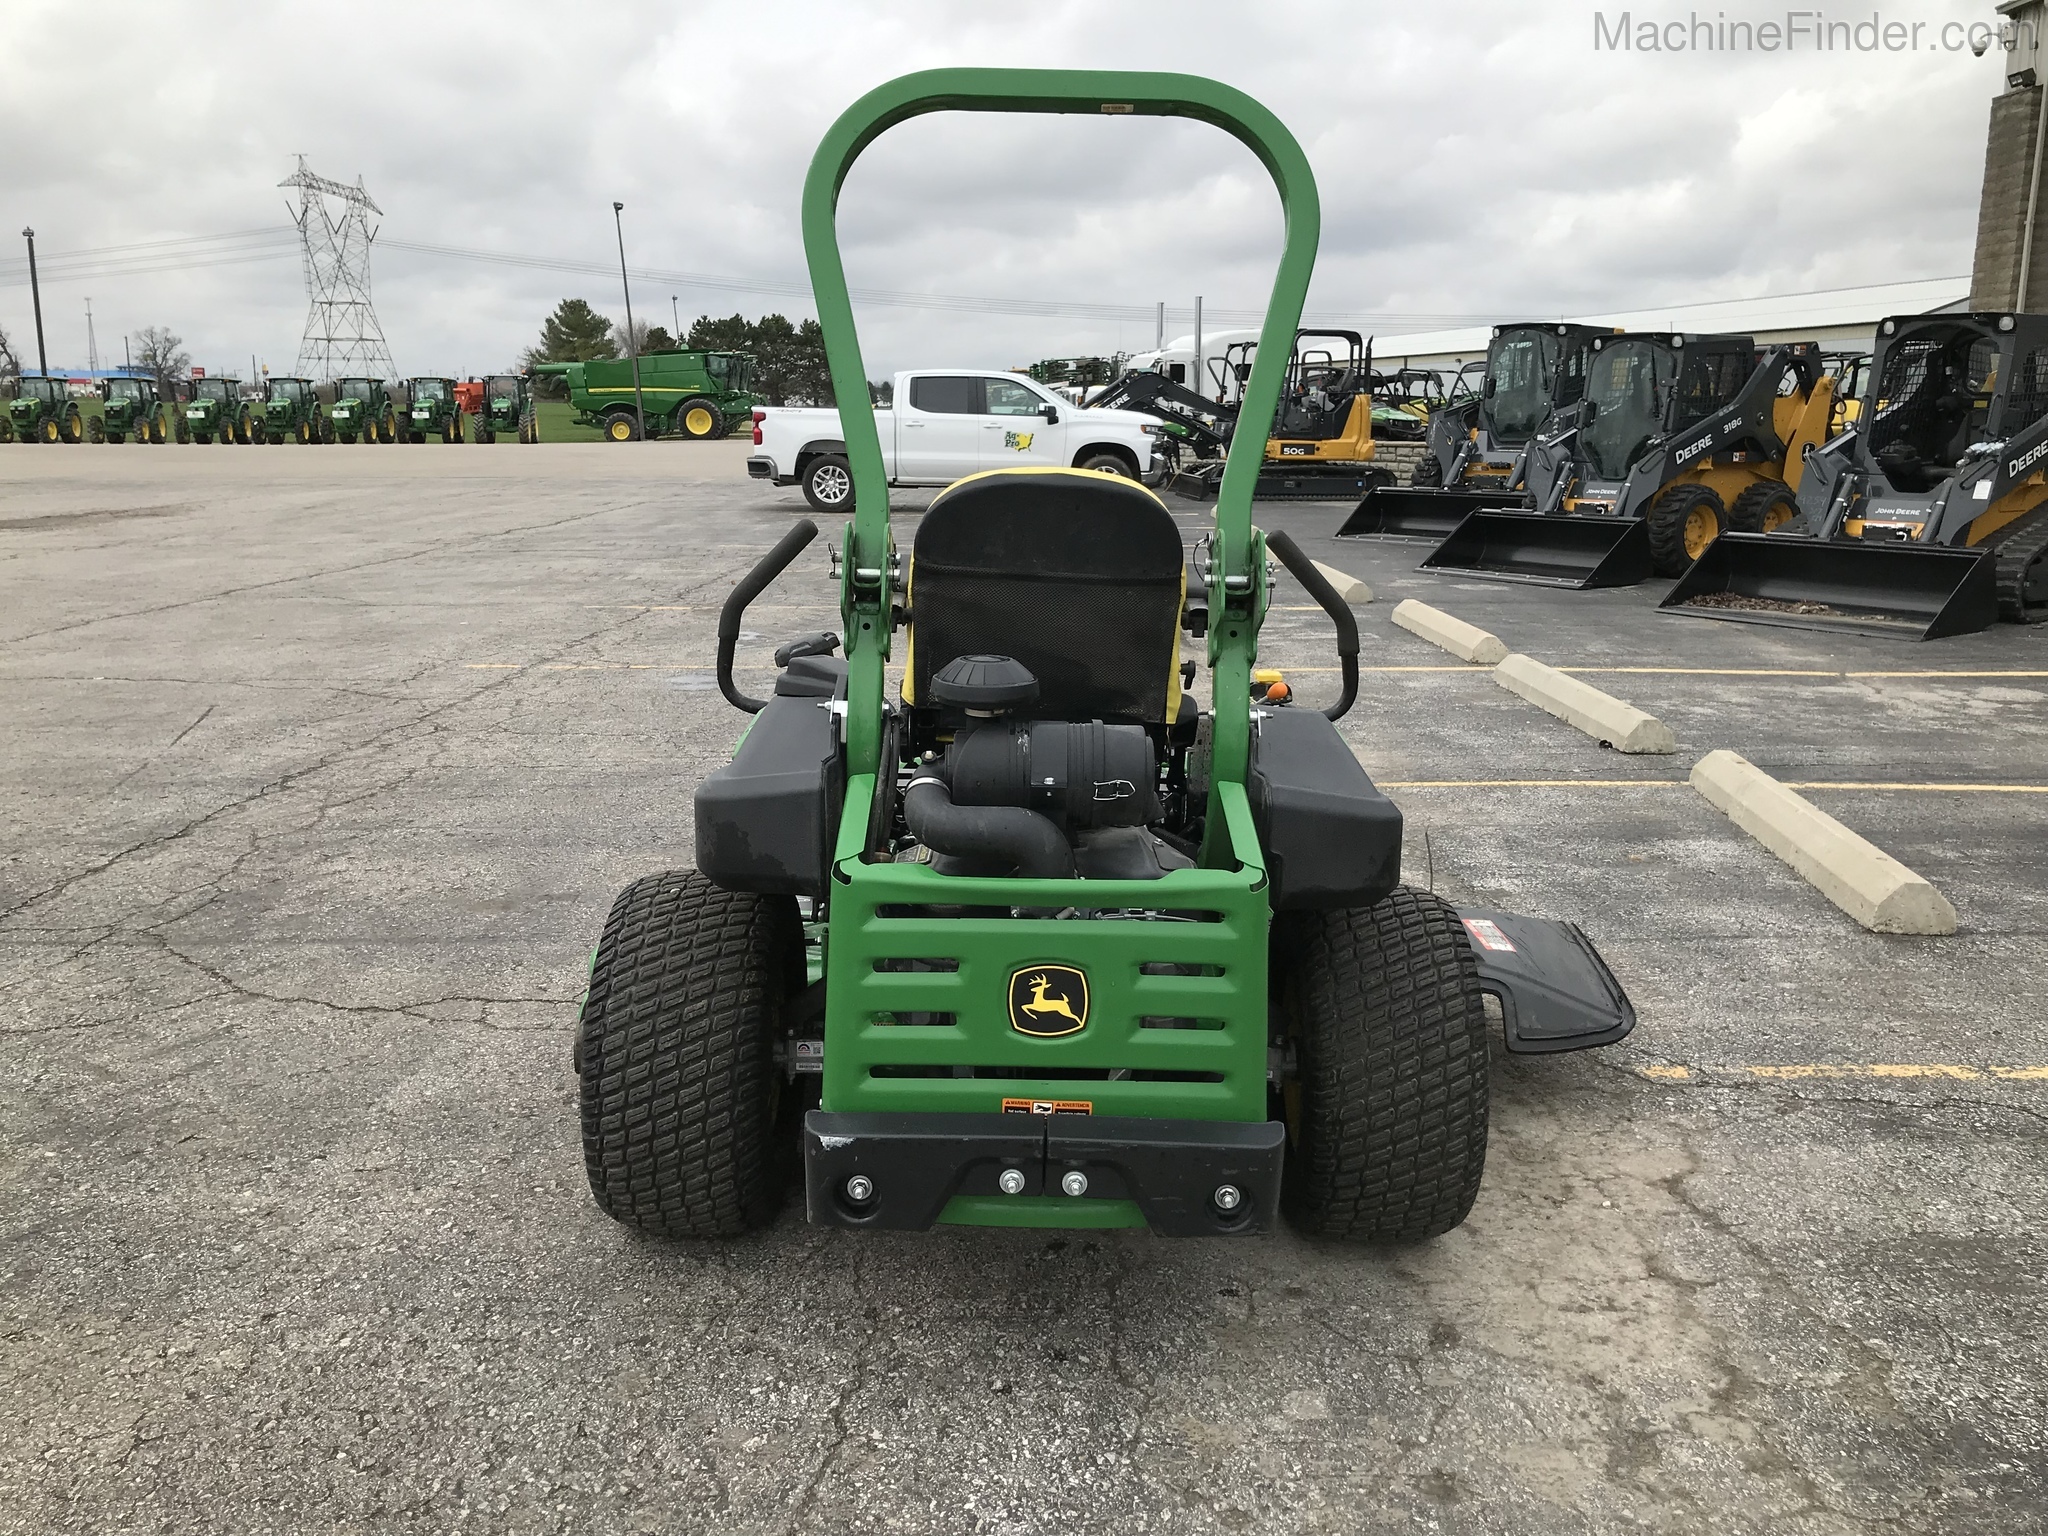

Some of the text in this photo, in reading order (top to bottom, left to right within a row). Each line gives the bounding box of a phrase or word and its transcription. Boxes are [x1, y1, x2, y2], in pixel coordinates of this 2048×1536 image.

[1104, 393, 1131, 410] ERE
[1722, 417, 1743, 434] 318G
[1004, 440, 1020, 448] Pro
[1283, 447, 1305, 455] 50G
[1675, 433, 1714, 465] DEERE
[2008, 439, 2048, 478] DEERE
